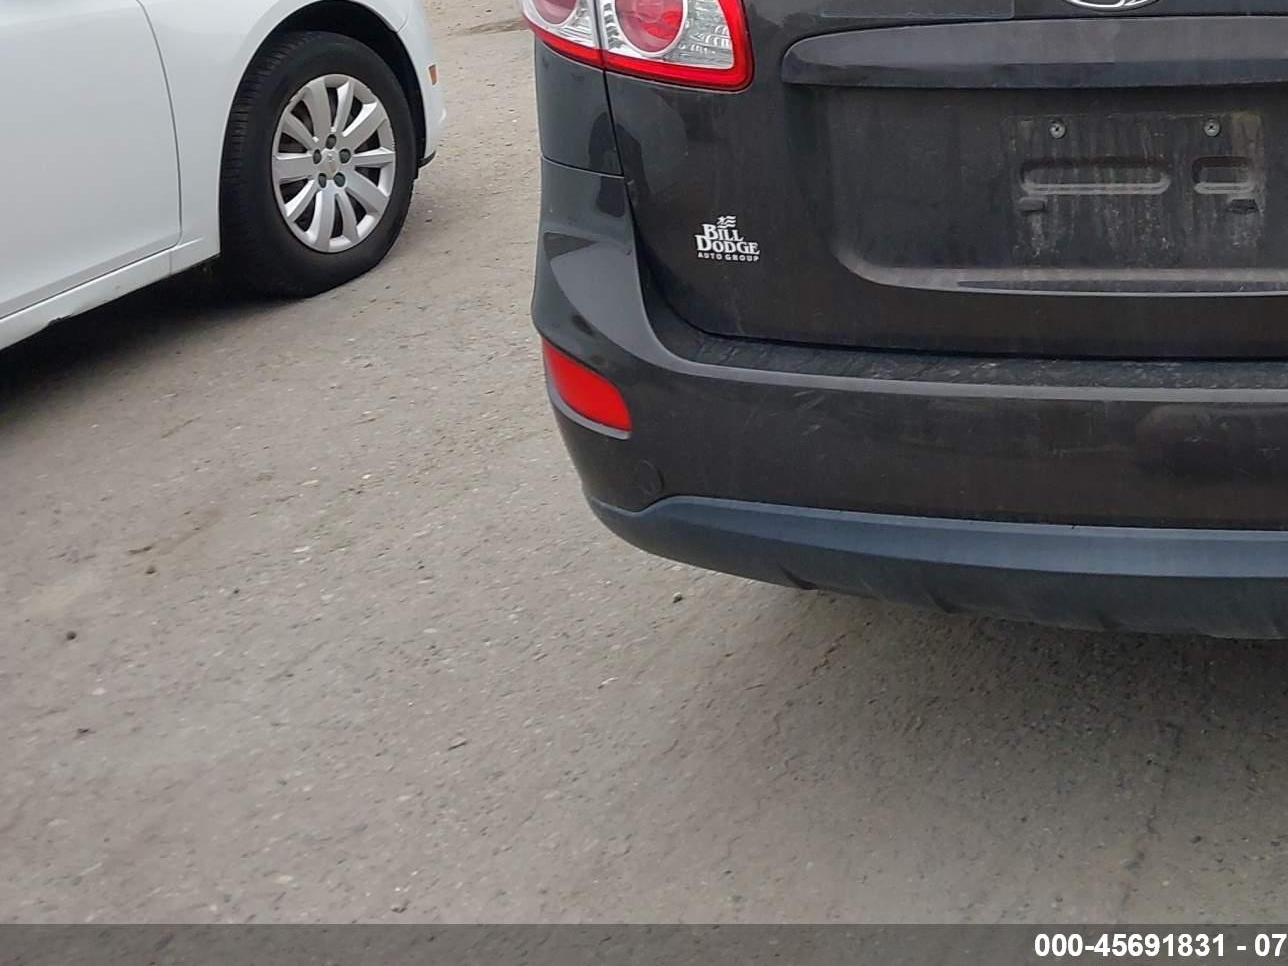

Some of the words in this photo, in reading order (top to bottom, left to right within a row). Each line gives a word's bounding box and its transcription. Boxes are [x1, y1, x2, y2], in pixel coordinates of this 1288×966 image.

[702, 224, 744, 241] BILL
[695, 235, 760, 254] DODGE
[698, 252, 722, 260] AUTO
[725, 254, 760, 262] GROUP
